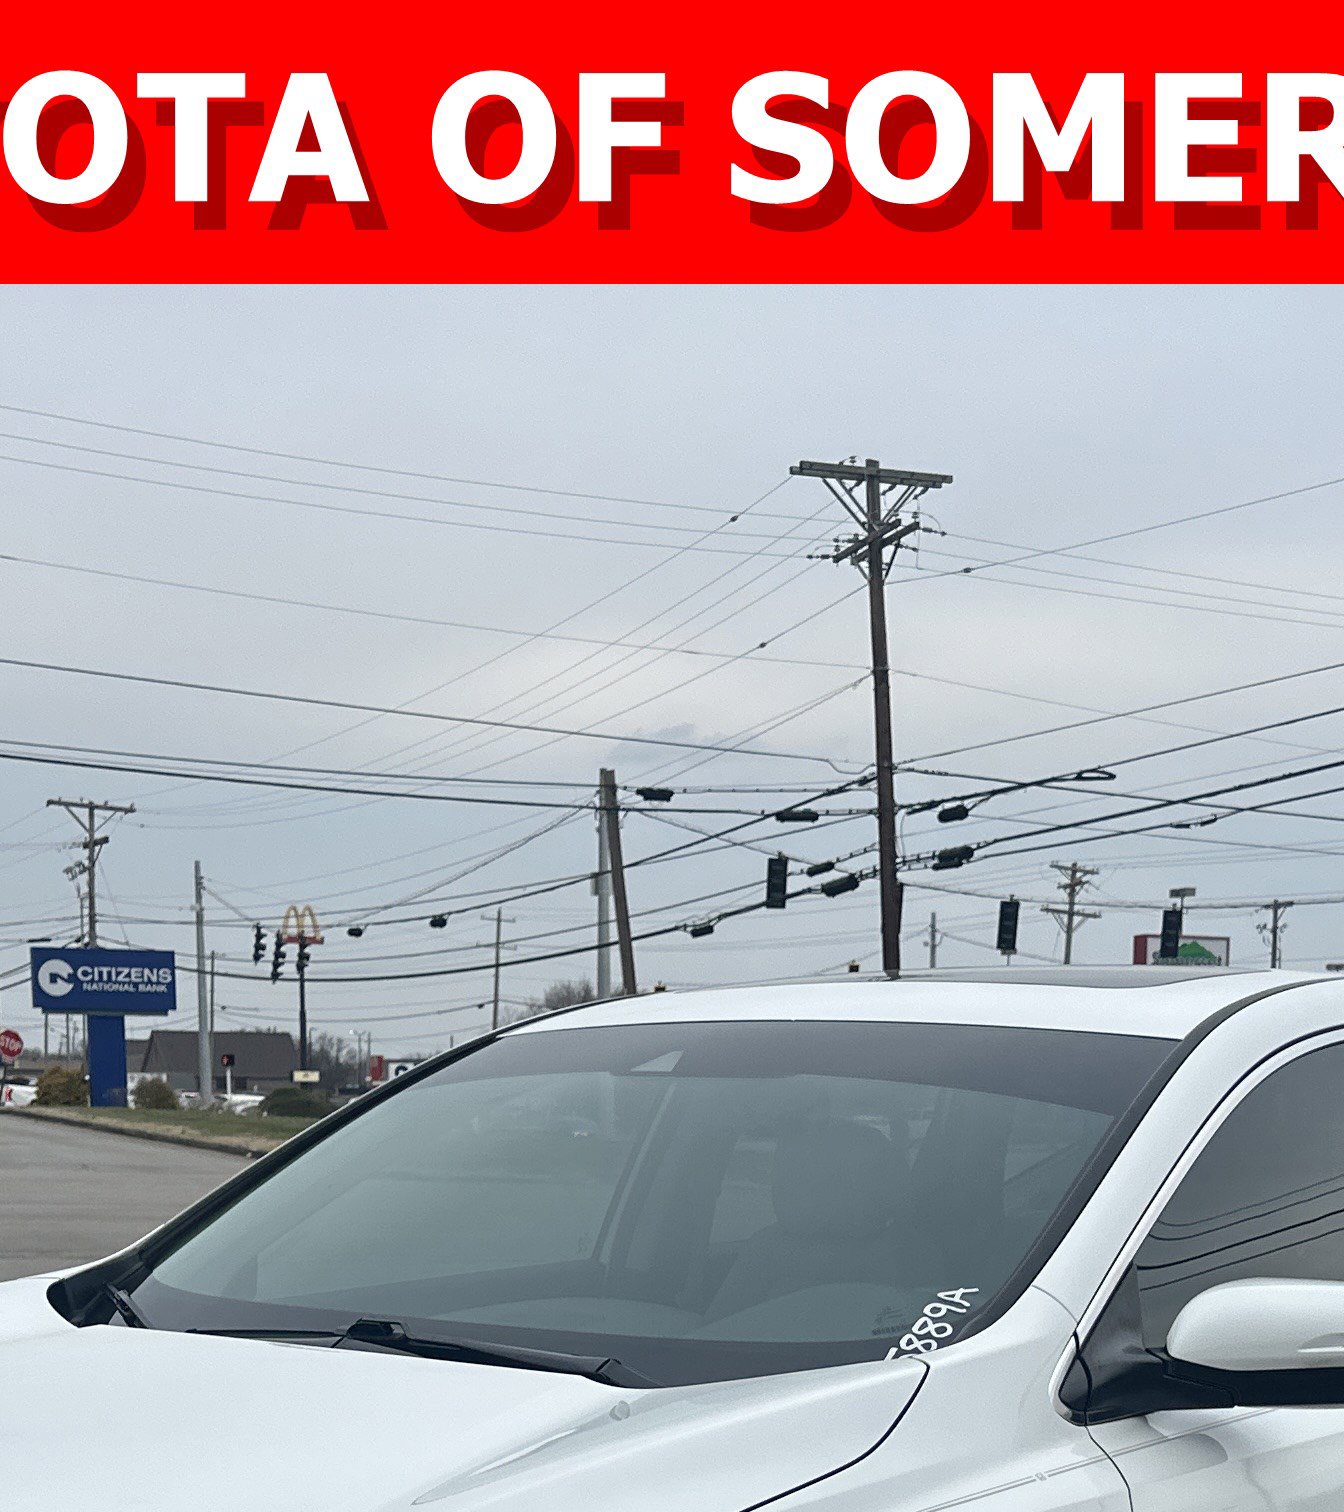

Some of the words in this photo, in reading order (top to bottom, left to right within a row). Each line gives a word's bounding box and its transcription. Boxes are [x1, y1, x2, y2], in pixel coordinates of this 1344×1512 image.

[76, 965, 173, 984] CITIZENS
[82, 982, 137, 993] NATIONAL
[138, 982, 169, 994] BANK
[0, 1033, 23, 1052] STOP
